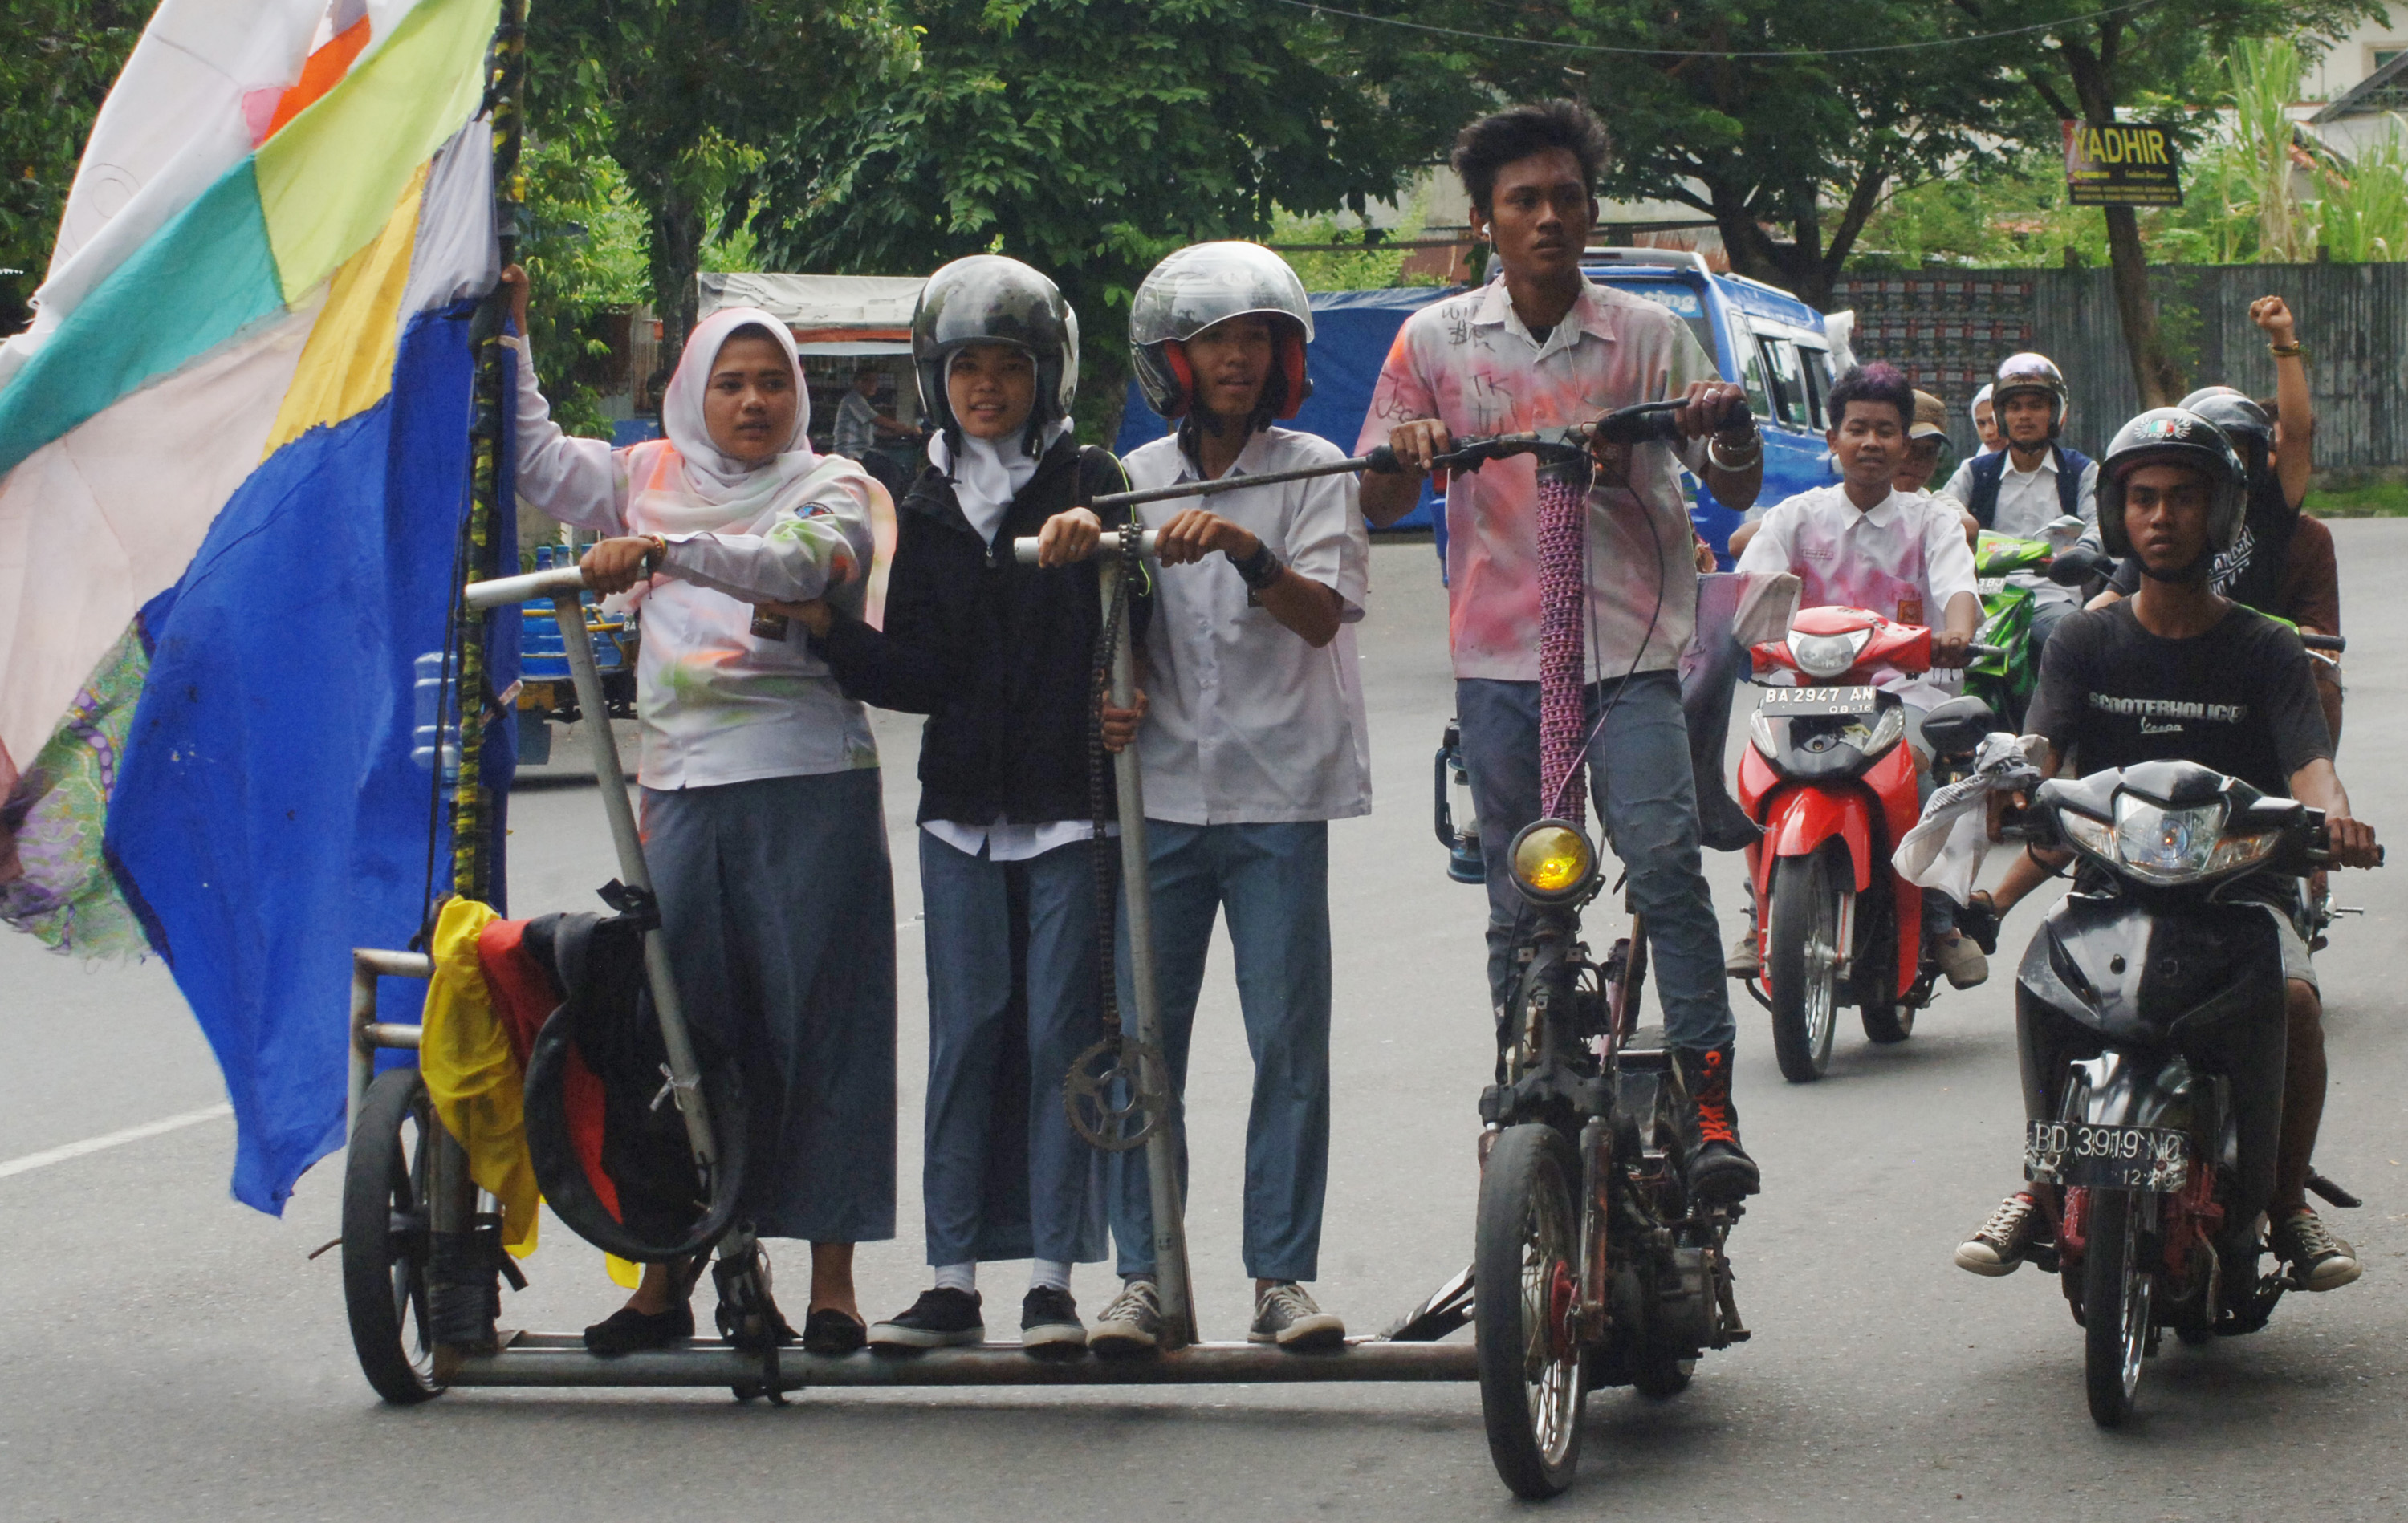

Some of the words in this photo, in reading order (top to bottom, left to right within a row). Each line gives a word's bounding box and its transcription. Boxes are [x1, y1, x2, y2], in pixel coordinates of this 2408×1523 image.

[2070, 126, 2169, 164] YADHIR
[624, 621, 637, 632] BA
[1765, 688, 1788, 703] BA
[1793, 688, 1841, 702] 2947
[1849, 687, 1874, 701] AN
[2140, 716, 2184, 734] Vespa
[2035, 1123, 2068, 1154] BD
[2077, 1127, 2139, 1159] 3919
